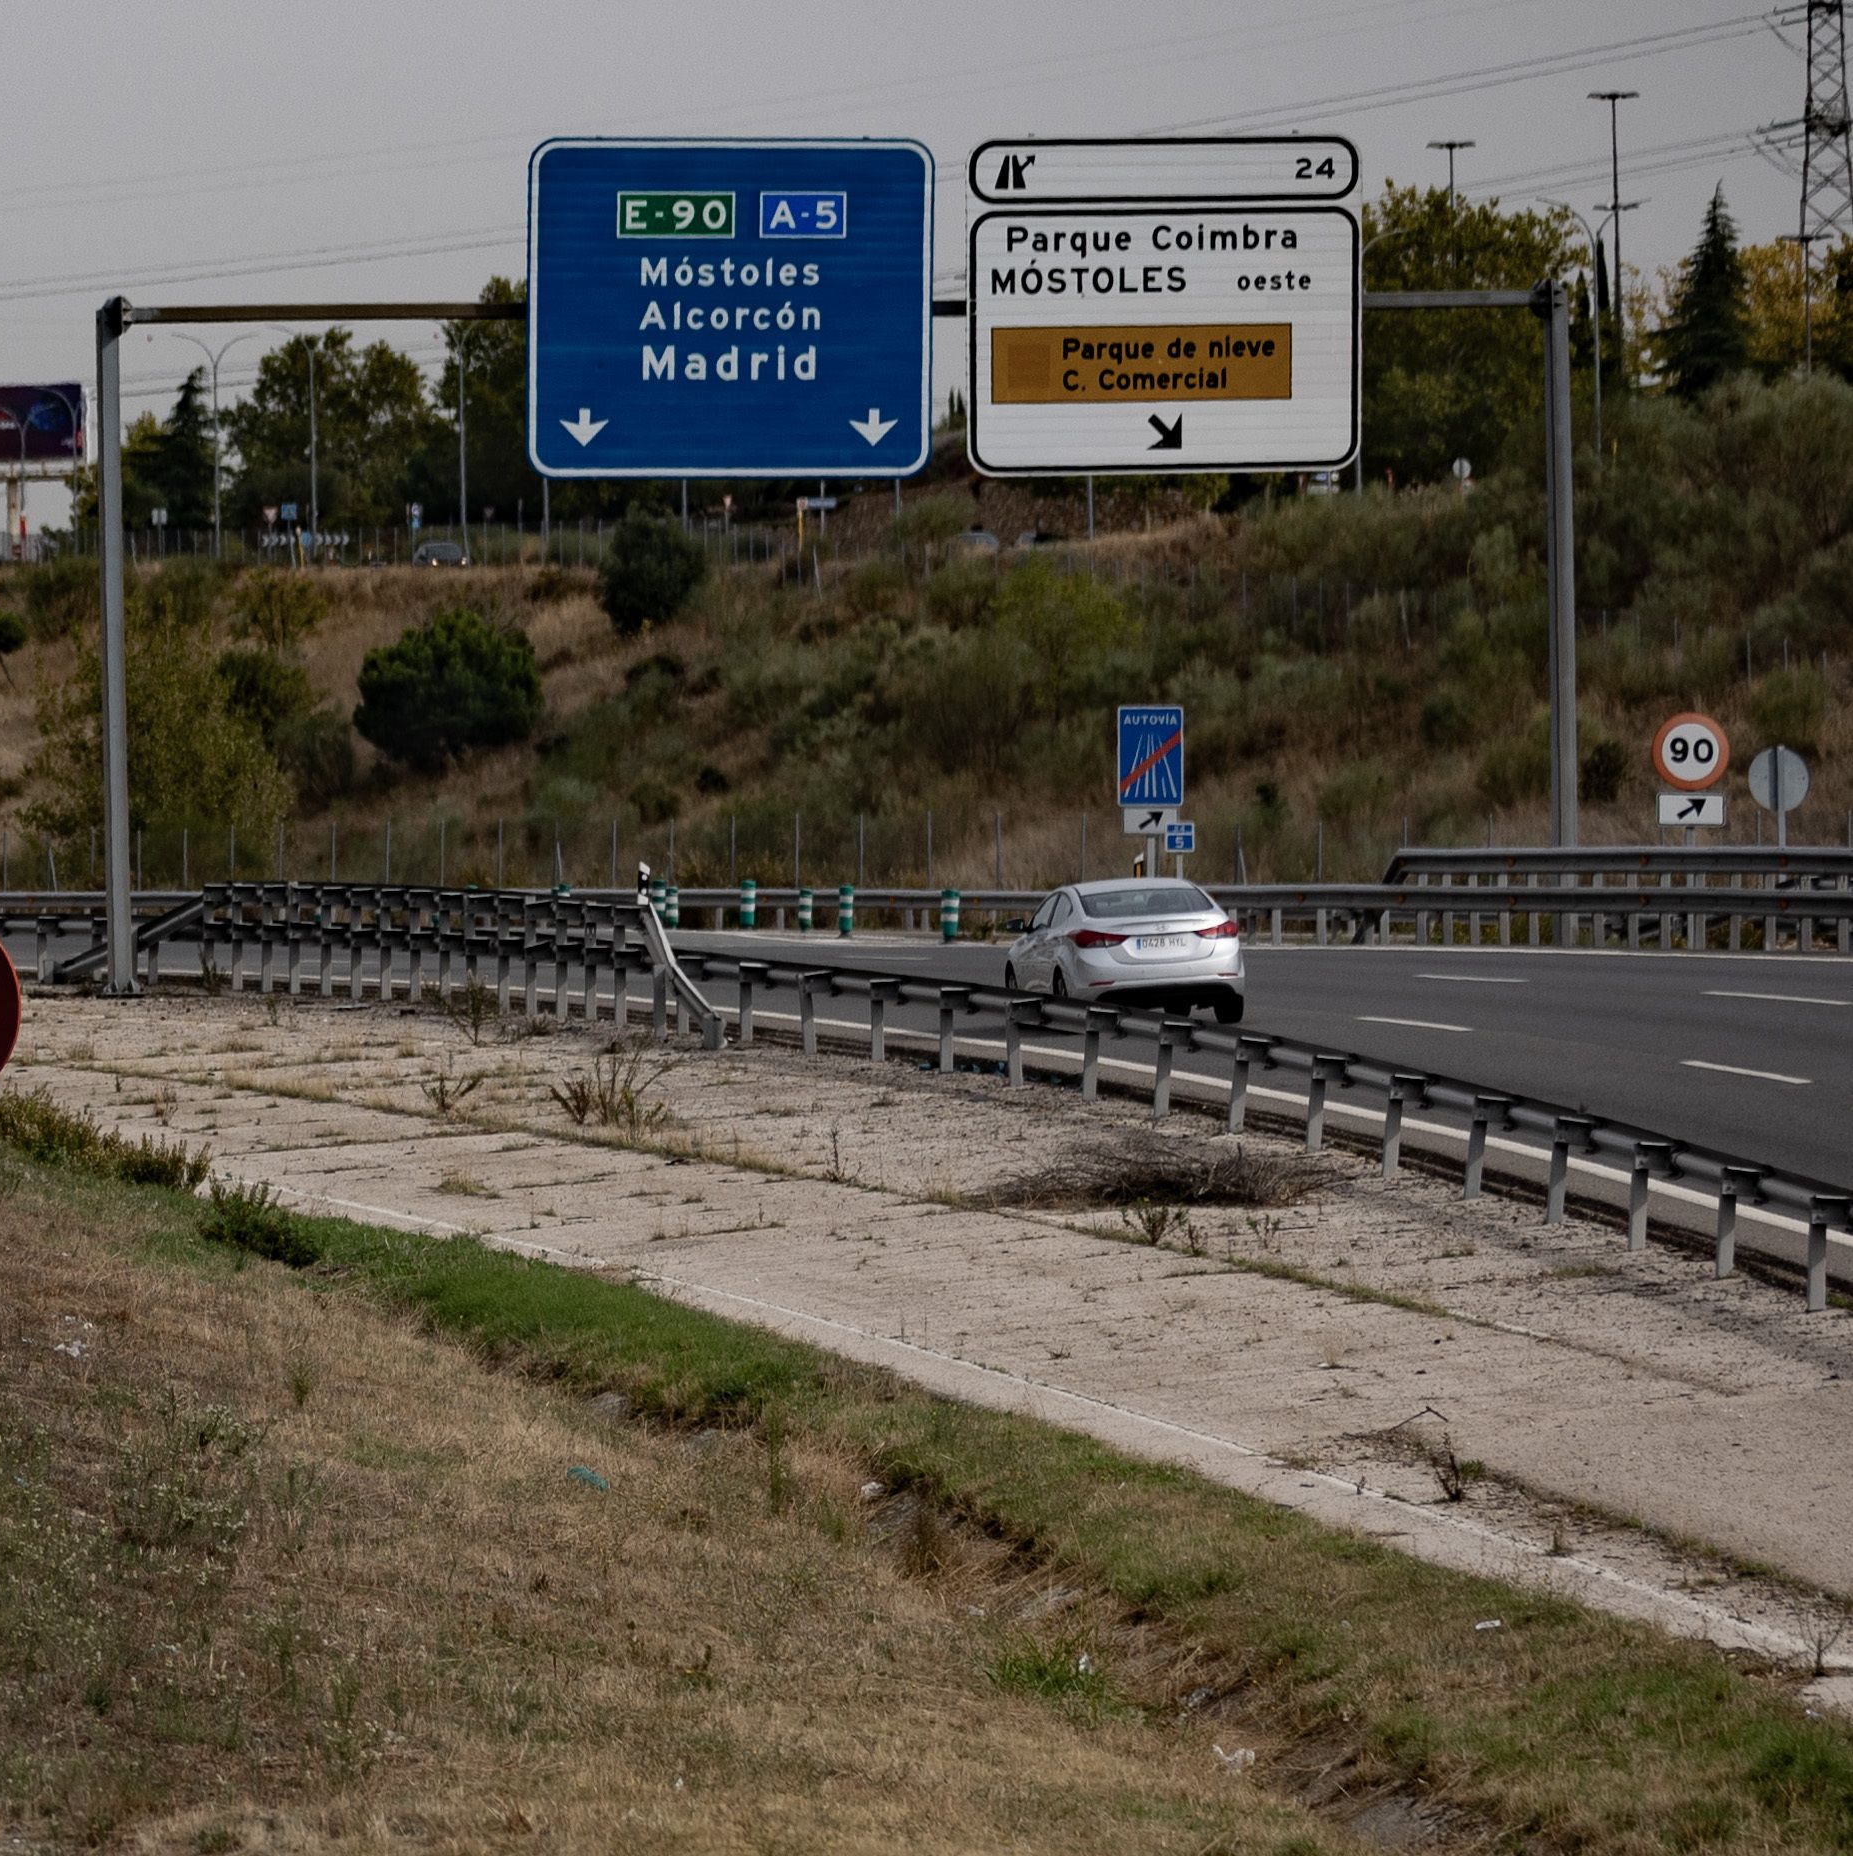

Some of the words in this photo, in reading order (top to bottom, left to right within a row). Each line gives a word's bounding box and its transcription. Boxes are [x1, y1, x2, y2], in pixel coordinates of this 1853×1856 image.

[1295, 158, 1336, 180] 24
[625, 200, 727, 231] E-90
[769, 200, 838, 230] A-5
[1006, 226, 1132, 258] Parque
[1152, 224, 1297, 252] Coimbra
[640, 256, 820, 287] Móstoles
[991, 260, 1187, 295] MÓSTOLES
[1238, 271, 1312, 291] oeste
[639, 301, 821, 331] Alcorcón
[642, 345, 817, 381] Madrid
[1063, 338, 1155, 365] Parque
[1167, 337, 1197, 359] de
[1209, 335, 1276, 358] nieve
[1062, 370, 1086, 391] C.
[1098, 368, 1228, 391] Comercial
[1124, 712, 1178, 726] AUTOVÍA
[1670, 737, 1714, 764] 90
[1175, 836, 1184, 849] 5
